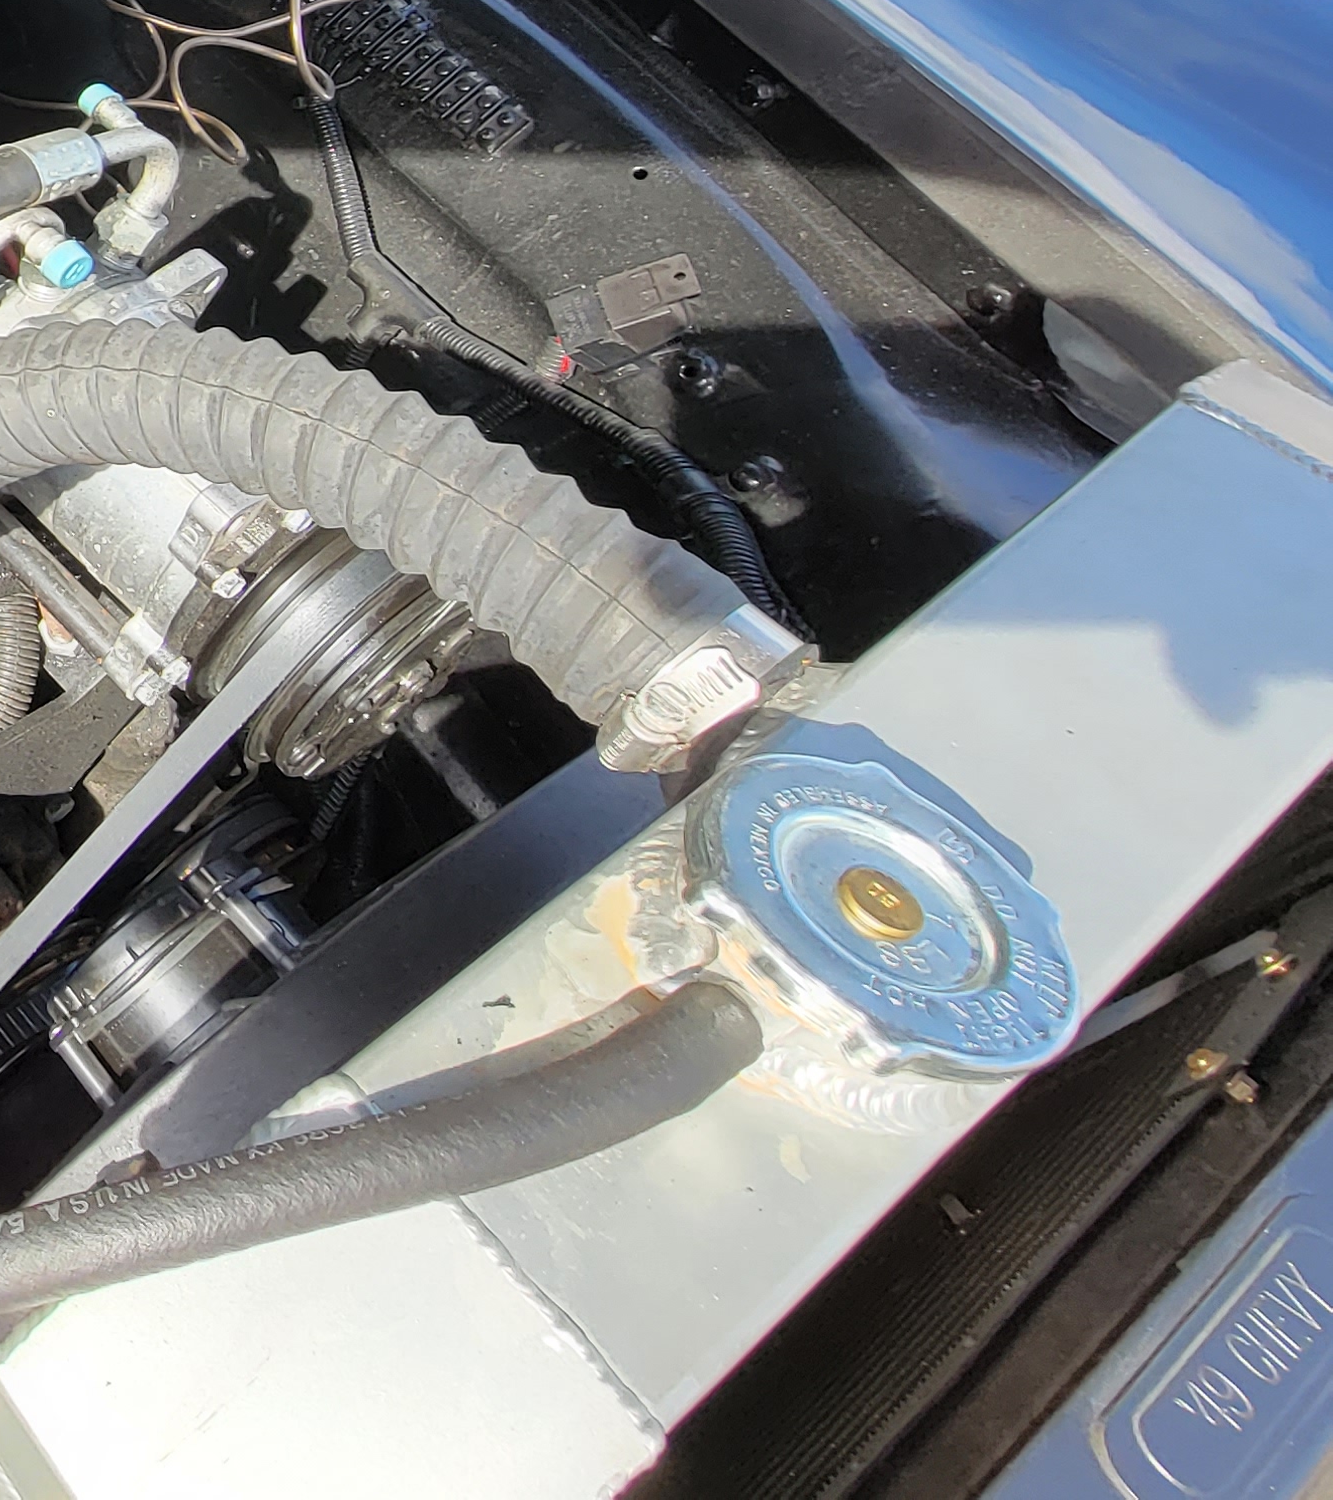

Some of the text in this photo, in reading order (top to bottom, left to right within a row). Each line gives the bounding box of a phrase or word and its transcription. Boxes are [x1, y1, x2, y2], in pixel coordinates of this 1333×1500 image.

[749, 785, 888, 893] ASSEMBLED IN MEXICO
[862, 884, 1037, 1026] DO NOT OPEN HOT
[1036, 955, 1071, 1019] KEEP
[120, 1175, 152, 1200] IN
